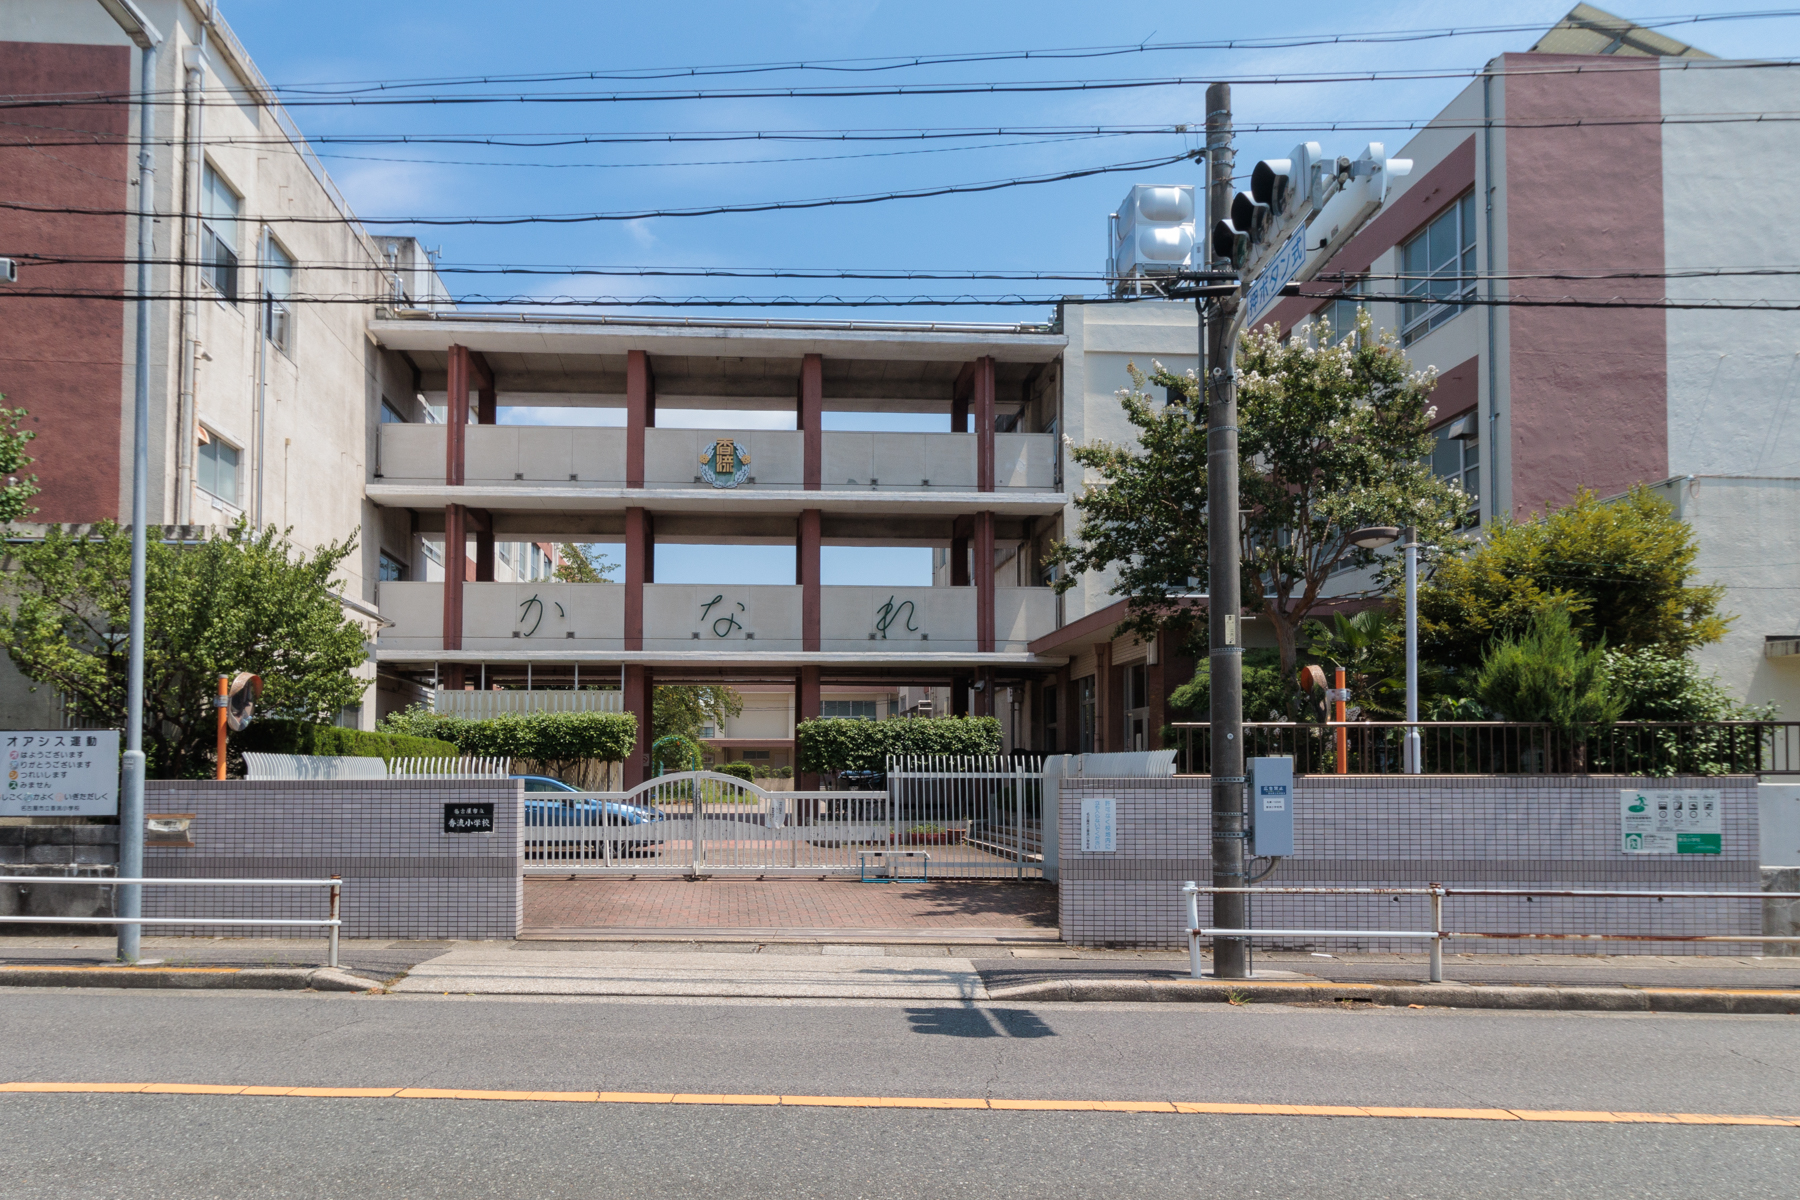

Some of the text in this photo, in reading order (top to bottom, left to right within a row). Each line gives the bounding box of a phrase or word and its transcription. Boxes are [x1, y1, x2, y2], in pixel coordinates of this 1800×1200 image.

[1249, 236, 1303, 317] 押ボタン式
[6, 735, 98, 747] オアシス運動
